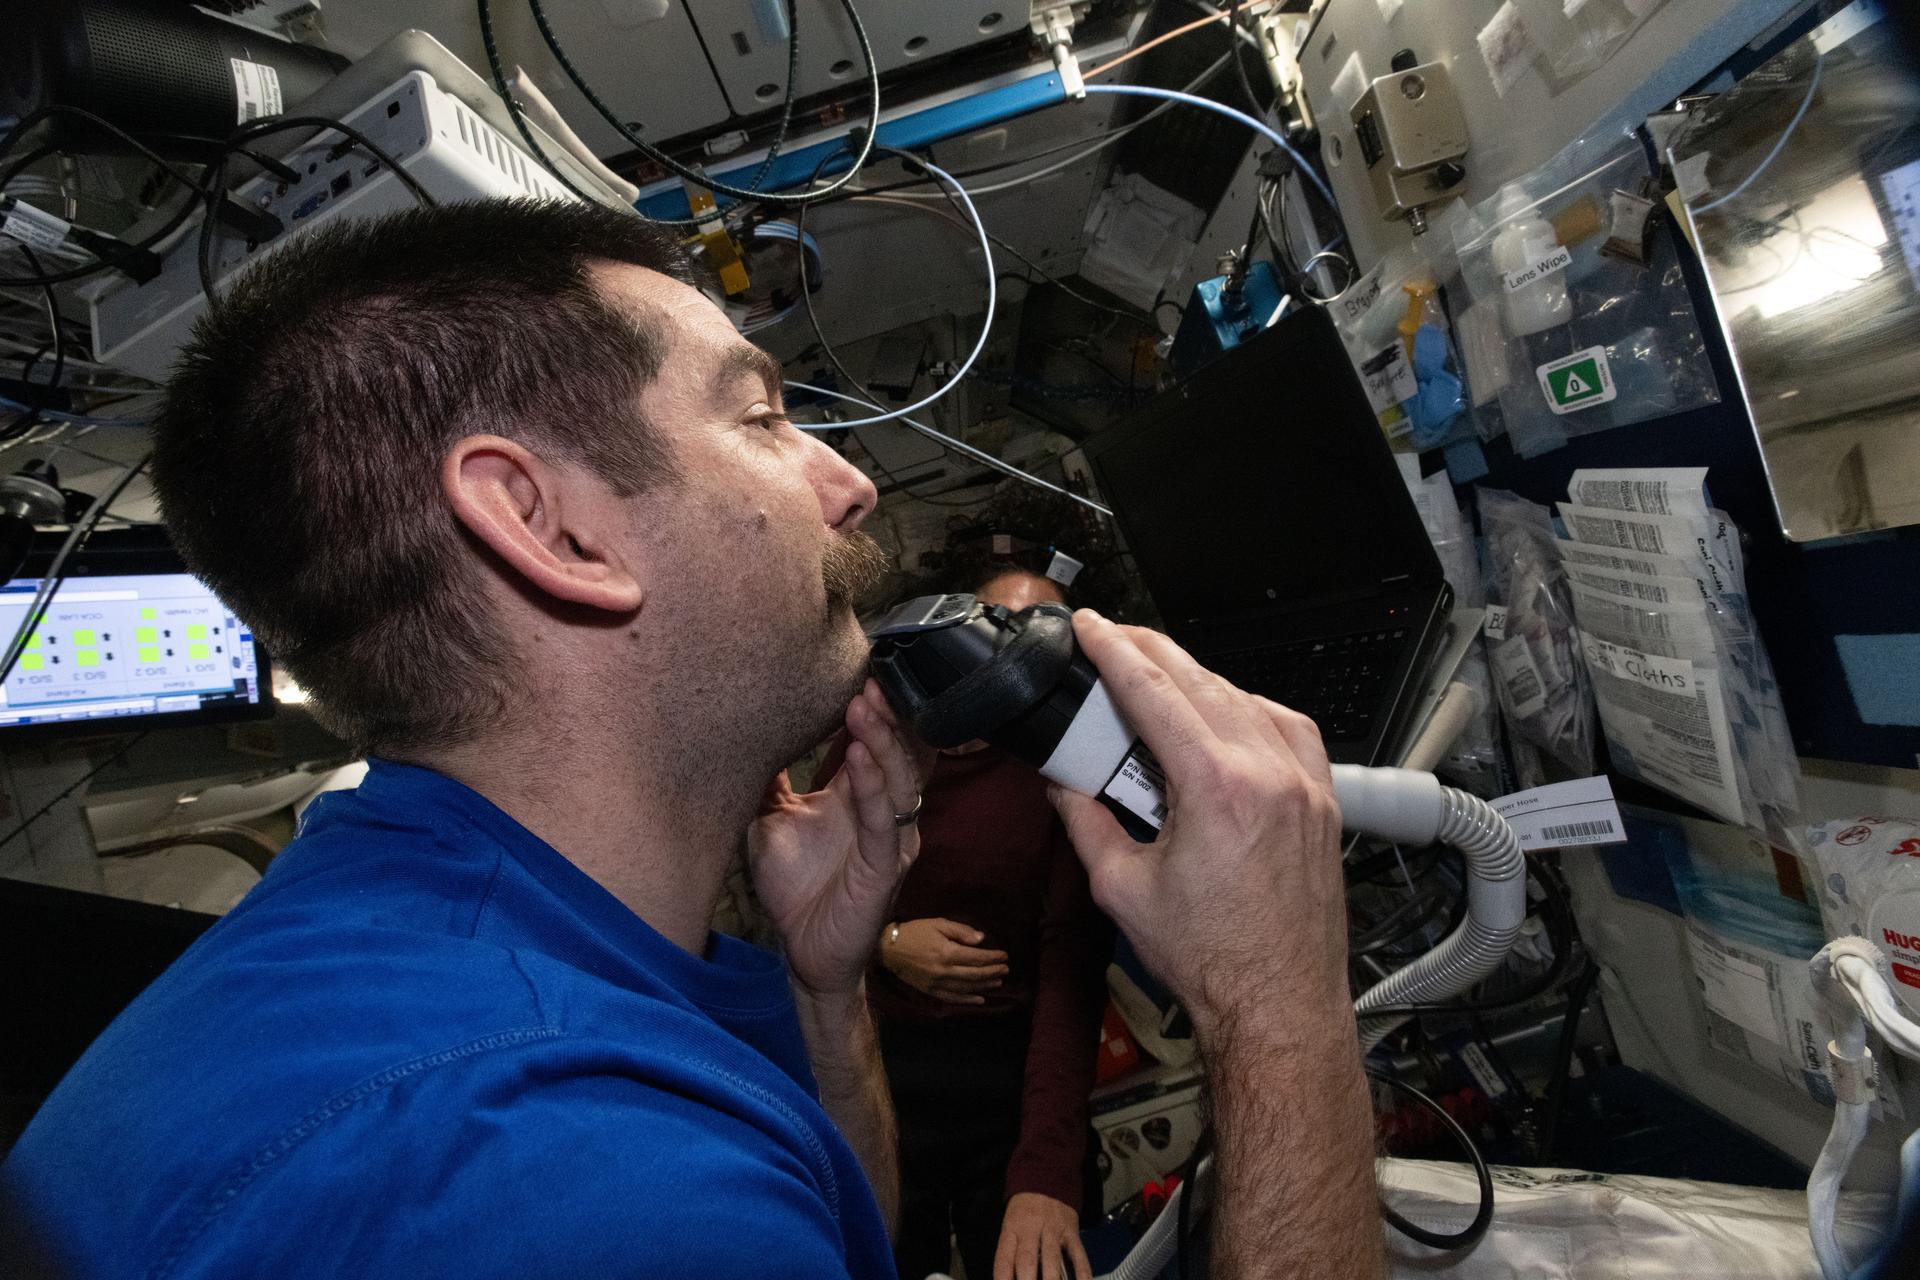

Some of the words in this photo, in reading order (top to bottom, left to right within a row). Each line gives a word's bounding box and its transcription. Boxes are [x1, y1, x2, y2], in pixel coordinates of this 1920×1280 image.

[1509, 270, 1536, 289] Lens
[1537, 253, 1568, 273] Wipe
[1570, 379, 1580, 393] 0
[1625, 660, 1686, 688] Cloths
[1126, 762, 1141, 774] P/N
[1121, 769, 1136, 781] S/N
[1135, 778, 1152, 792] 1002
[1517, 797, 1539, 807] Hose
